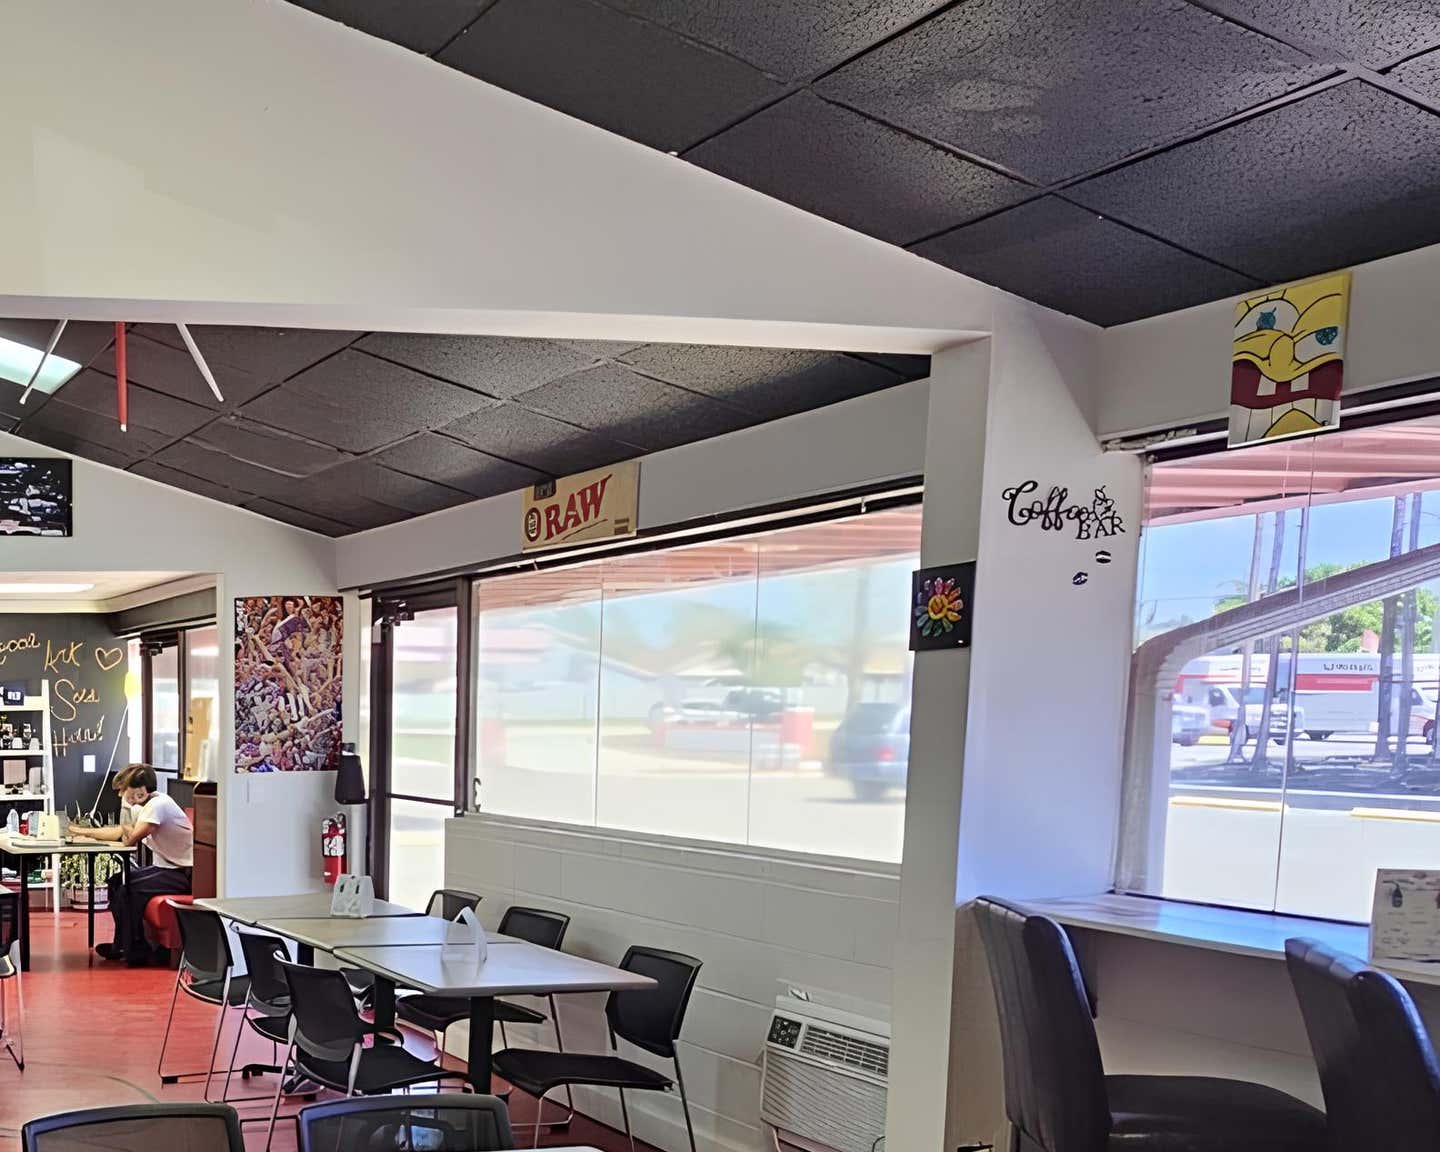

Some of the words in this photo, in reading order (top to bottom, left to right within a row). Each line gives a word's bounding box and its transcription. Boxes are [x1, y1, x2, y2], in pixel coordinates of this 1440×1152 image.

[544, 474, 613, 541] RAW
[1002, 480, 1096, 531] Coffee
[1075, 510, 1126, 540] BAR
